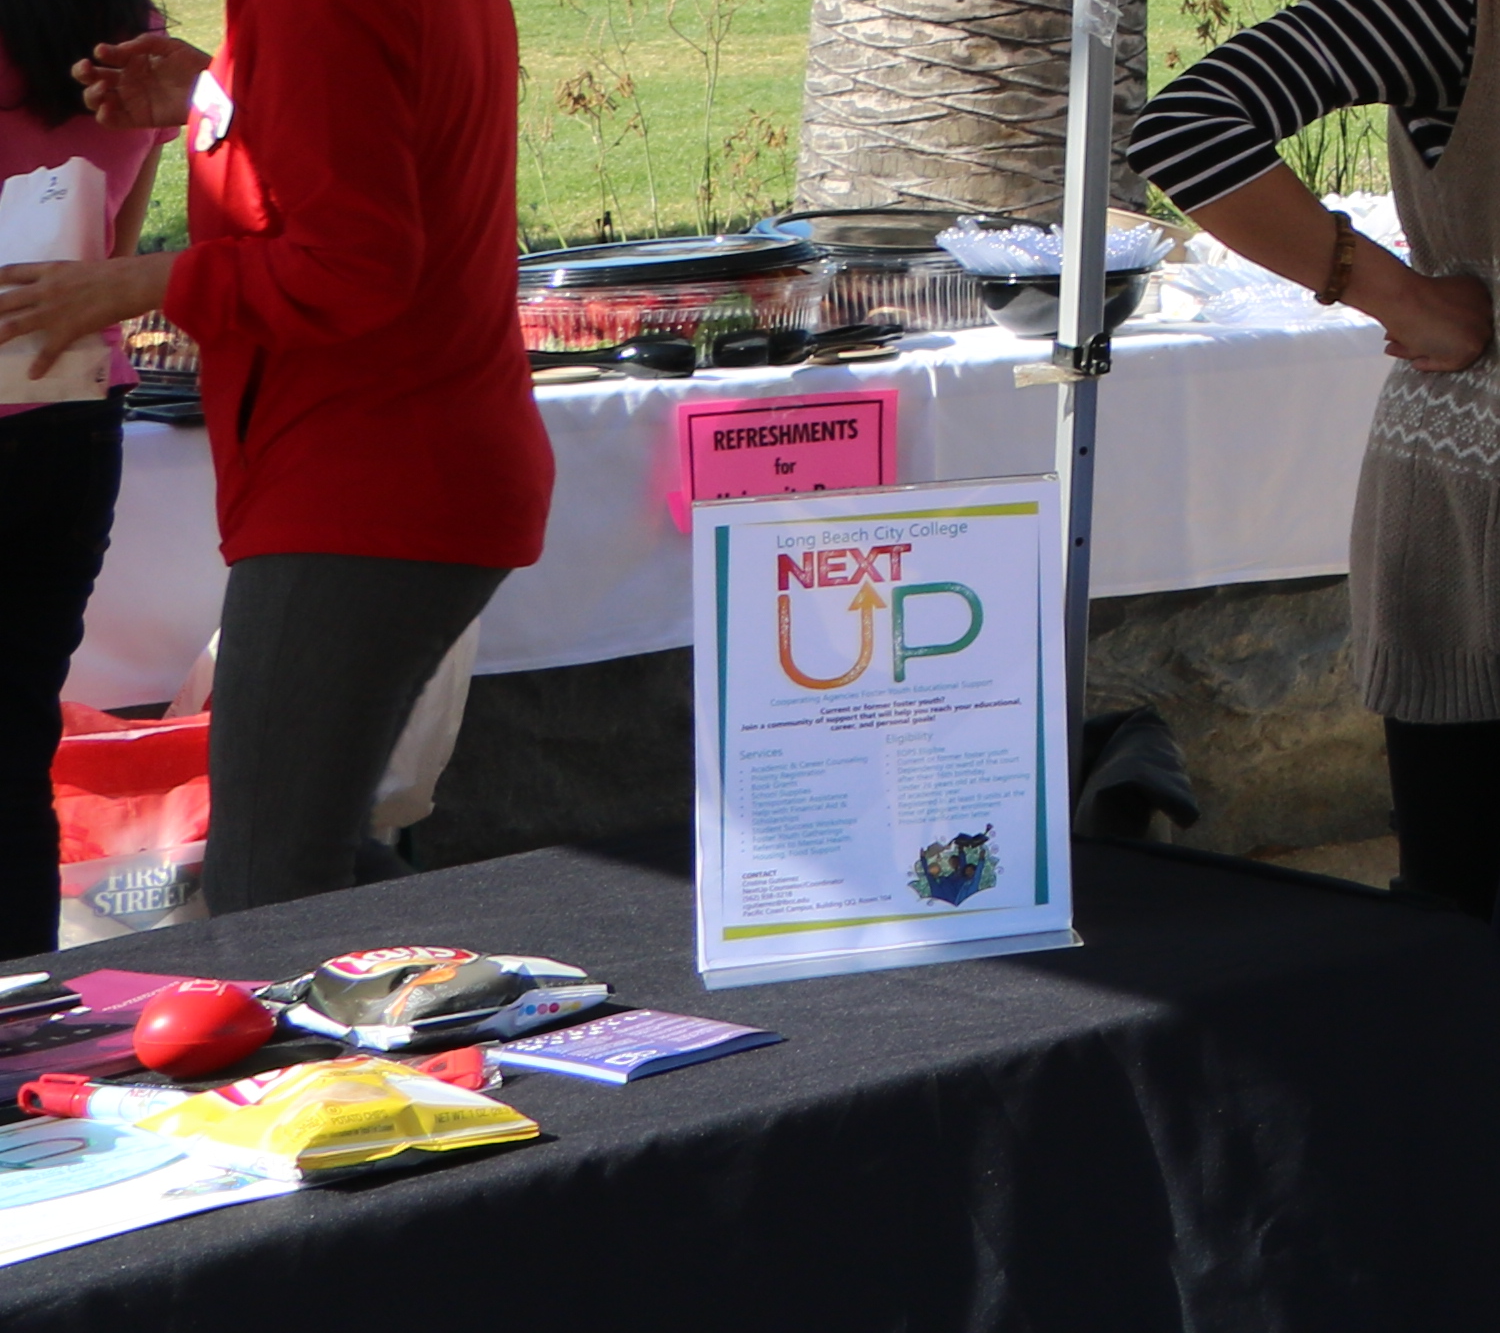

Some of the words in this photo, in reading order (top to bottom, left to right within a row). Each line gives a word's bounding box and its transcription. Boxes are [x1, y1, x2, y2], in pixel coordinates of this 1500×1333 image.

[714, 419, 858, 451] REFRESHMENTS
[774, 457, 796, 475] for
[777, 532, 816, 550] Long
[822, 528, 869, 546] Beach
[874, 525, 905, 544] City
[909, 520, 968, 539] College
[778, 543, 912, 590] NEXT
[778, 581, 984, 690] UP
[94, 882, 191, 917] STREET
